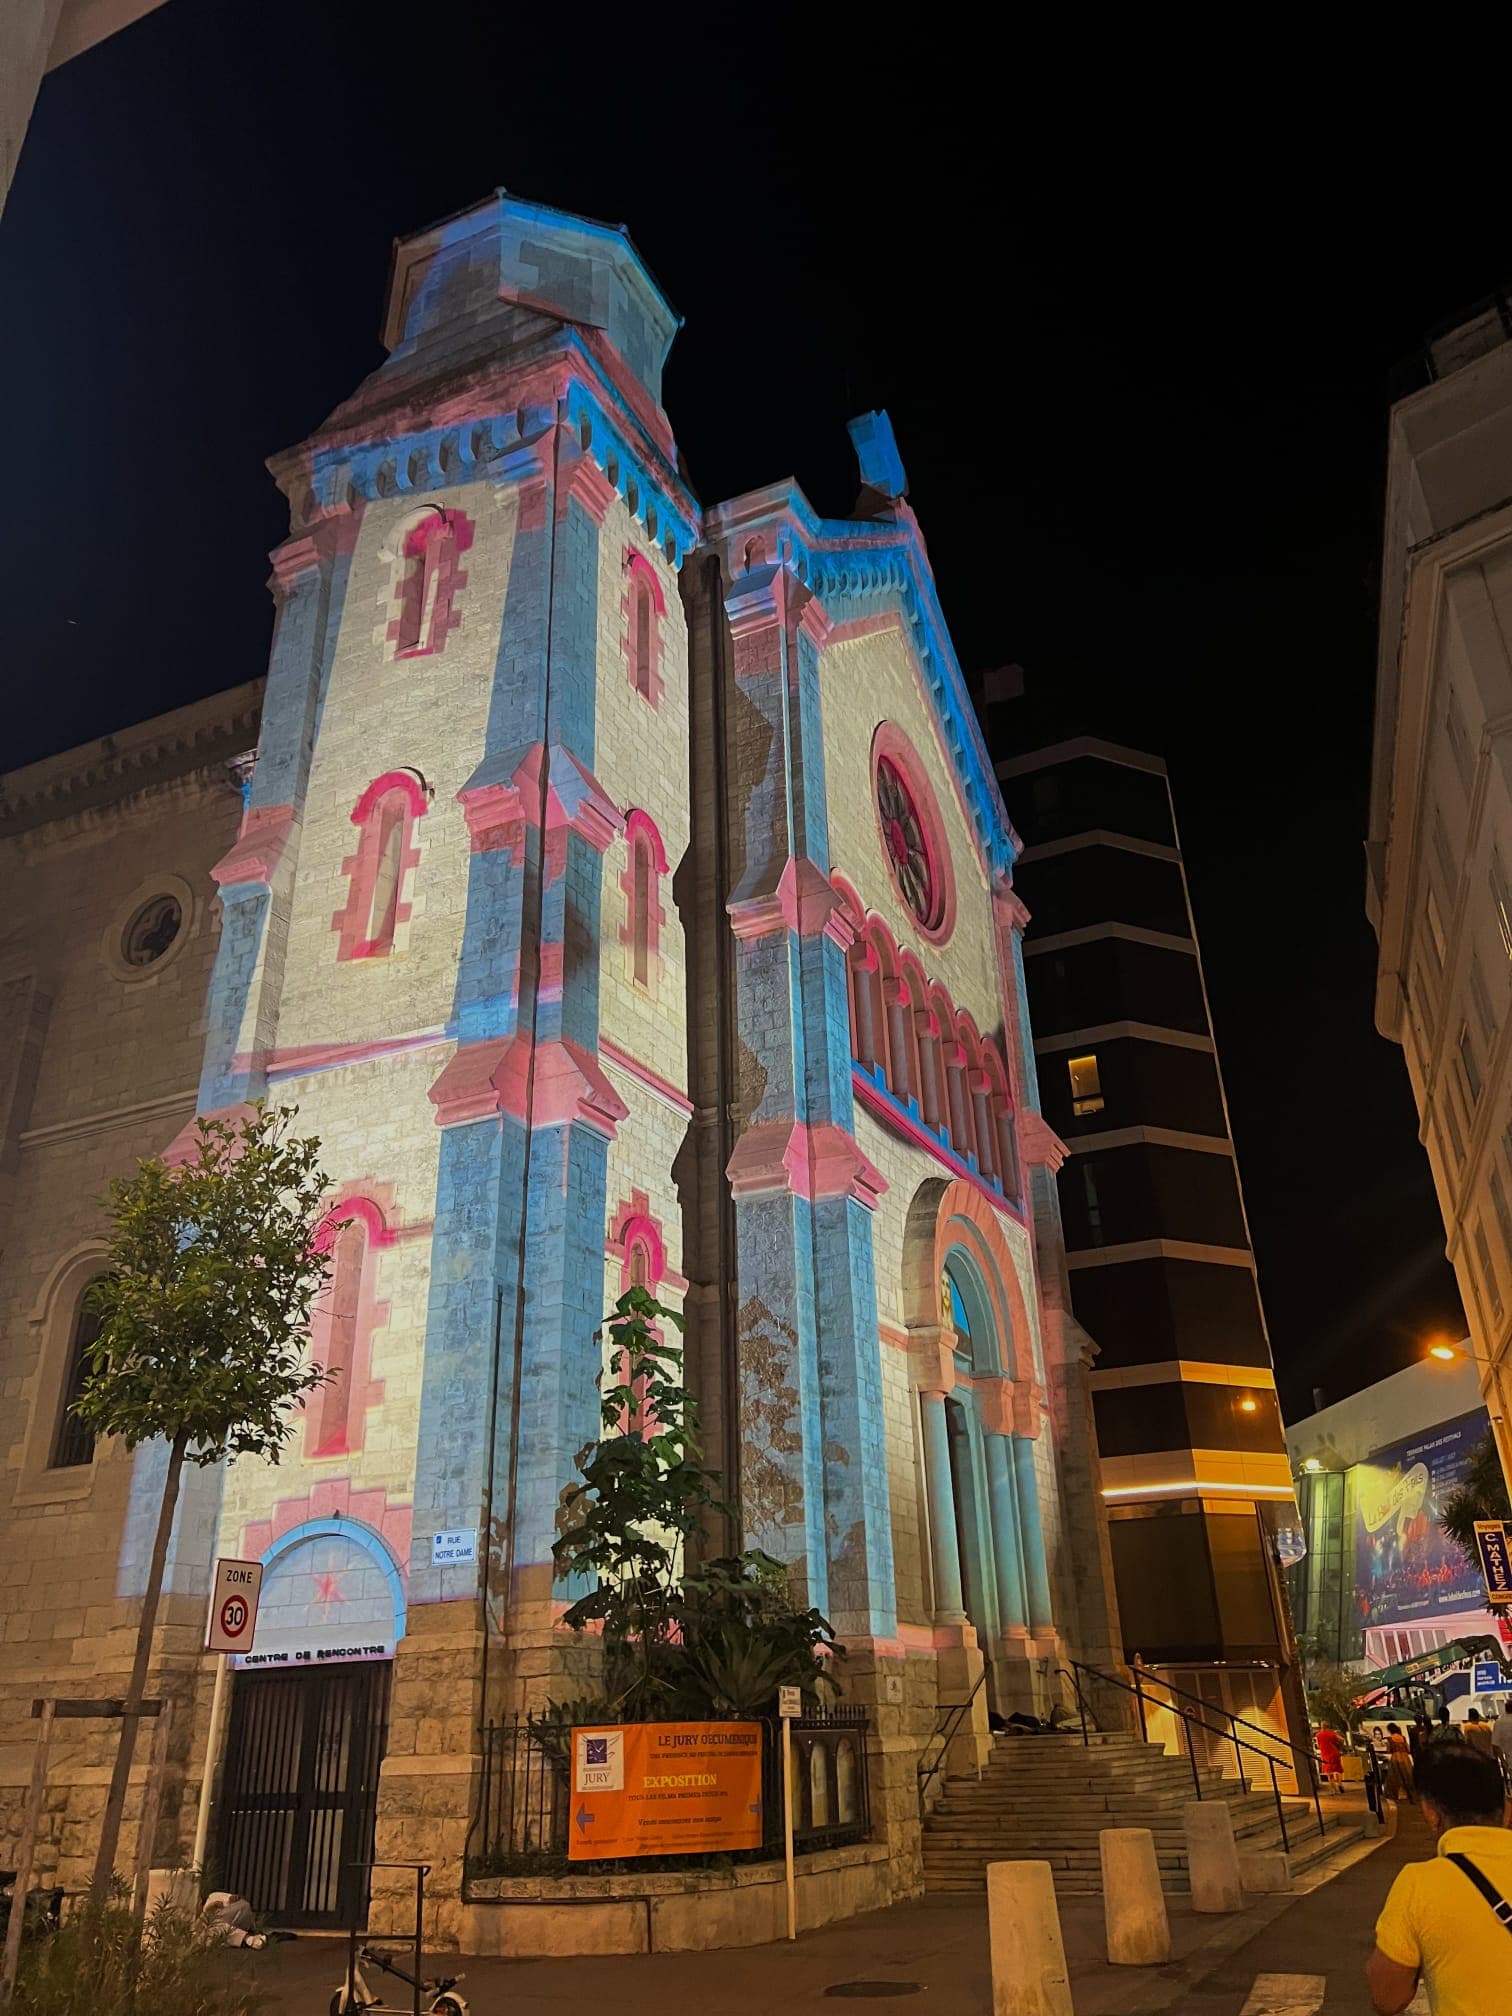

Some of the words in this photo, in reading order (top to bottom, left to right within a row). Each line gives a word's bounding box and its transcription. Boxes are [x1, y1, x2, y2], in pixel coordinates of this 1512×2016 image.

[447, 1535, 461, 1544] RUE
[1485, 1533, 1499, 1542] C
[435, 1550, 455, 1559] NOTRE
[456, 1548, 472, 1557] DAME
[1487, 1544, 1509, 1590] MATHEZ
[226, 1569, 253, 1584] ZONE
[225, 1606, 243, 1626] 30
[245, 1653, 288, 1664] CENTRE
[295, 1651, 311, 1660] DE
[317, 1645, 385, 1659] RENCONTRE
[658, 1735, 671, 1747] LE
[671, 1734, 699, 1748] JURY
[584, 1771, 610, 1785] JURY
[643, 1774, 717, 1789] EXPOSITION
